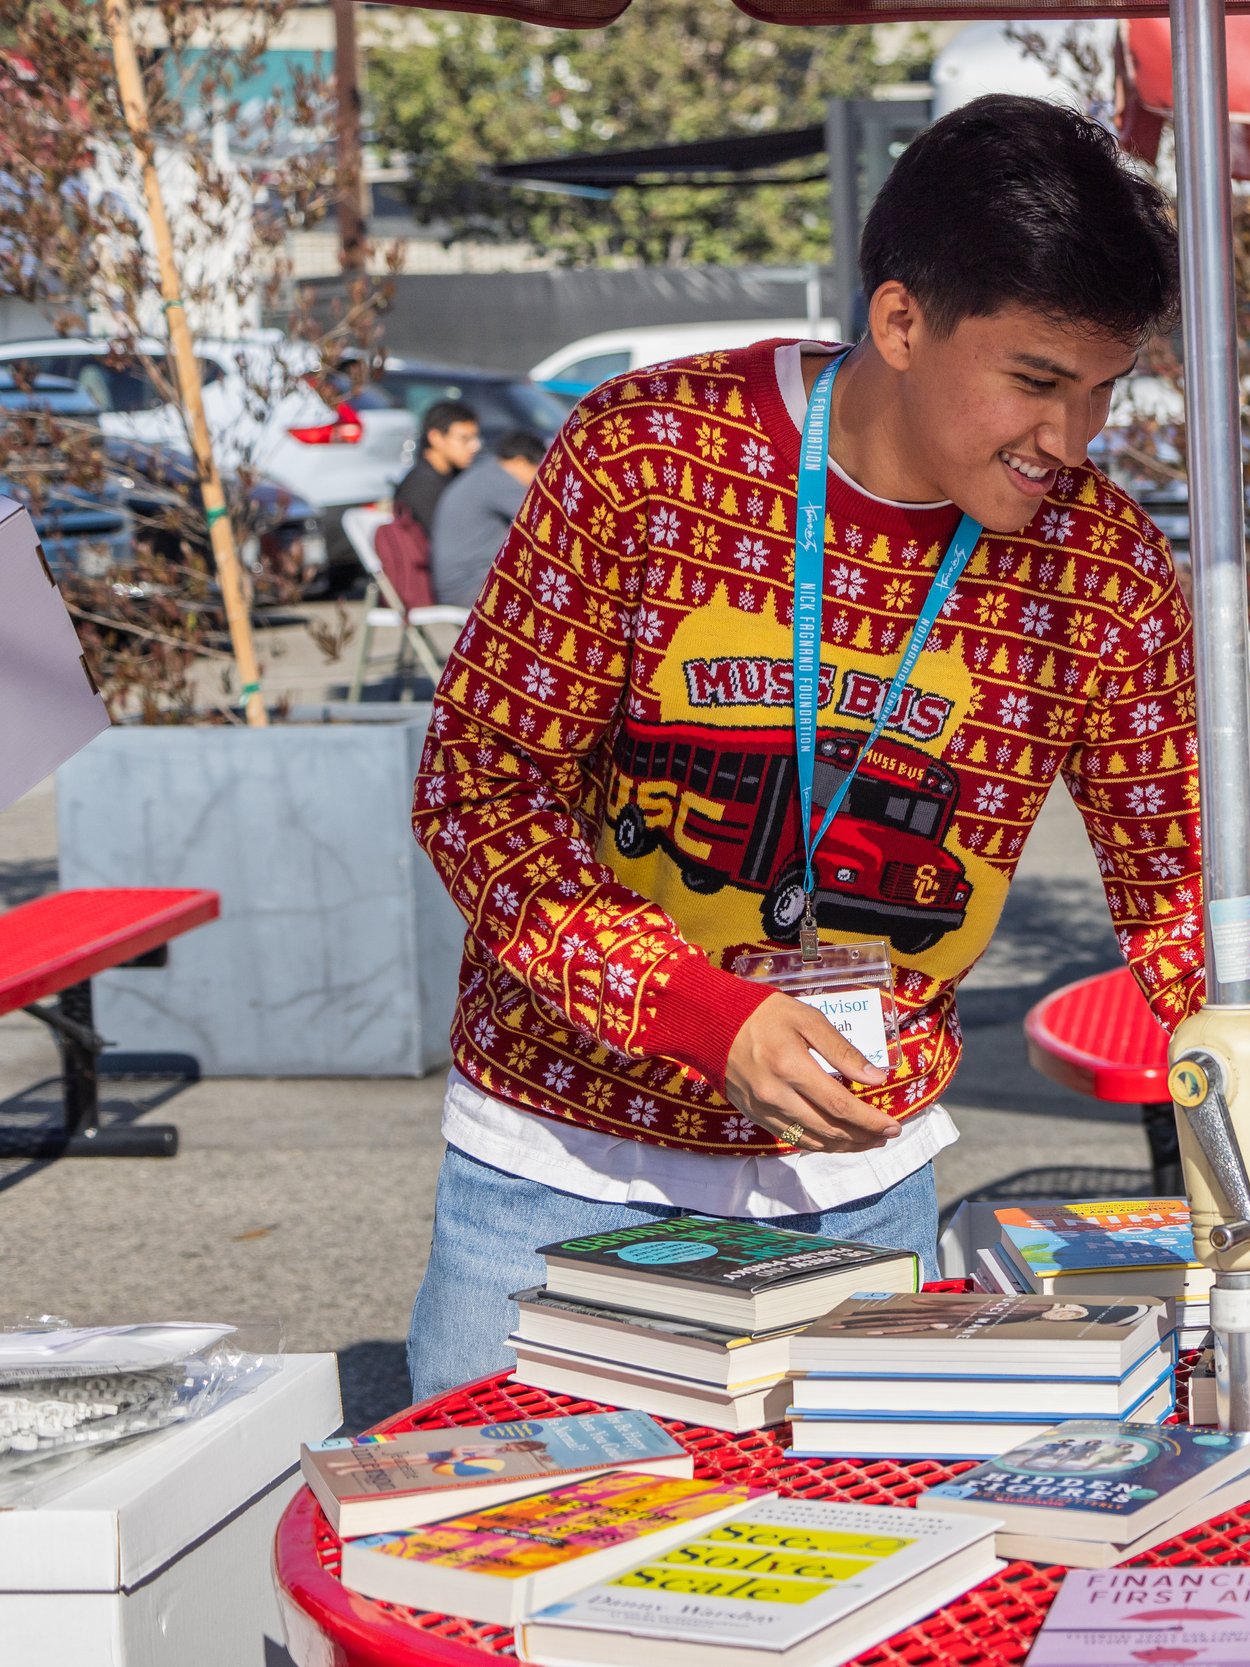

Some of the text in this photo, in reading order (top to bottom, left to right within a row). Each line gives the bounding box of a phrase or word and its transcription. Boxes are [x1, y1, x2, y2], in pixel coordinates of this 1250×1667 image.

[805, 398, 826, 471] FOUNDATION
[799, 582, 815, 753] NICK FAGNANO FOUNDATION
[894, 617, 930, 688] FOUNDATION
[835, 669, 955, 743] BUS
[606, 764, 726, 860] USC
[812, 1000, 869, 1017] dvisor
[561, 1219, 704, 1252] WKWARD
[1026, 1212, 1192, 1229] SHINE
[1060, 1223, 1192, 1239] DOES
[1086, 1237, 1179, 1249] SUN
[1107, 1250, 1179, 1259] THE
[723, 1259, 785, 1281] PINSKY
[963, 1479, 1132, 1504] FIGURES
[980, 1471, 1144, 1496] HIDDEN
[716, 1522, 820, 1552] See,
[669, 1545, 834, 1582] Solve,
[617, 1567, 781, 1601] Scale
[1088, 1590, 1198, 1604] FIRST
[587, 1594, 667, 1616] Danny
[680, 1603, 781, 1625] Warshay
